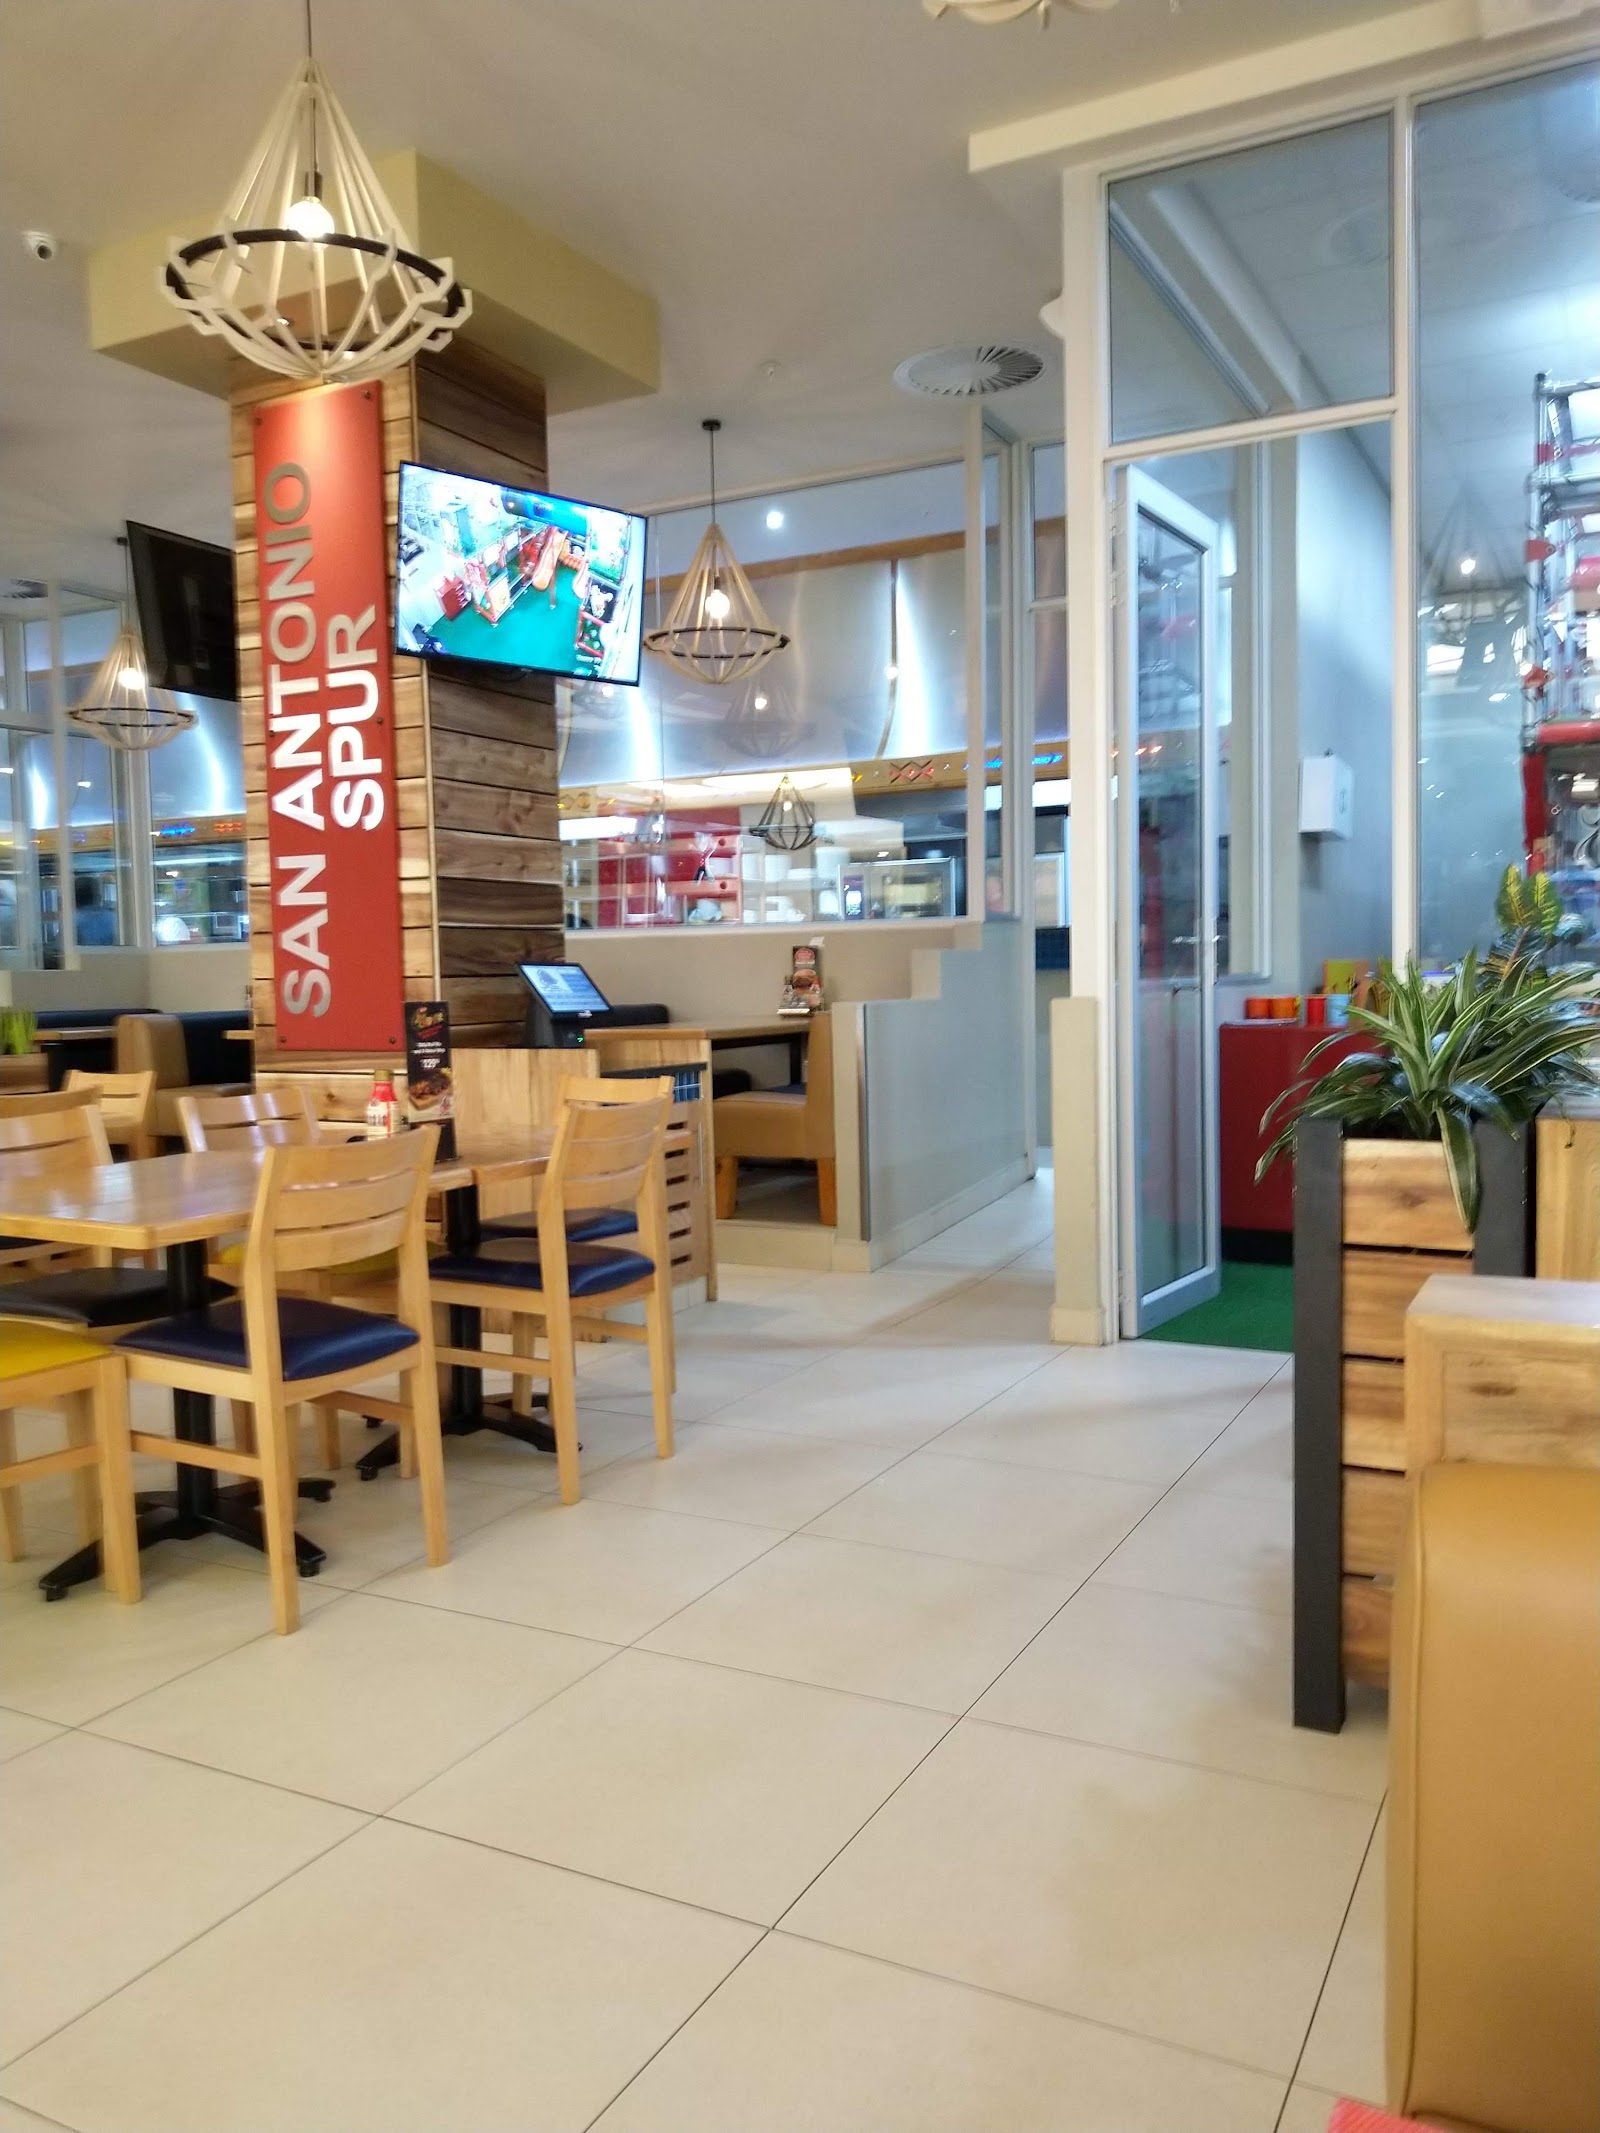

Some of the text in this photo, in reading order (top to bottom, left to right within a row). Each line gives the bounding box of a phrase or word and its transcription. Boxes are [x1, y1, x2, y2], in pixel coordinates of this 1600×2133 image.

[264, 462, 331, 1018] SAN ANTONIO
[326, 604, 384, 831] SPUR
